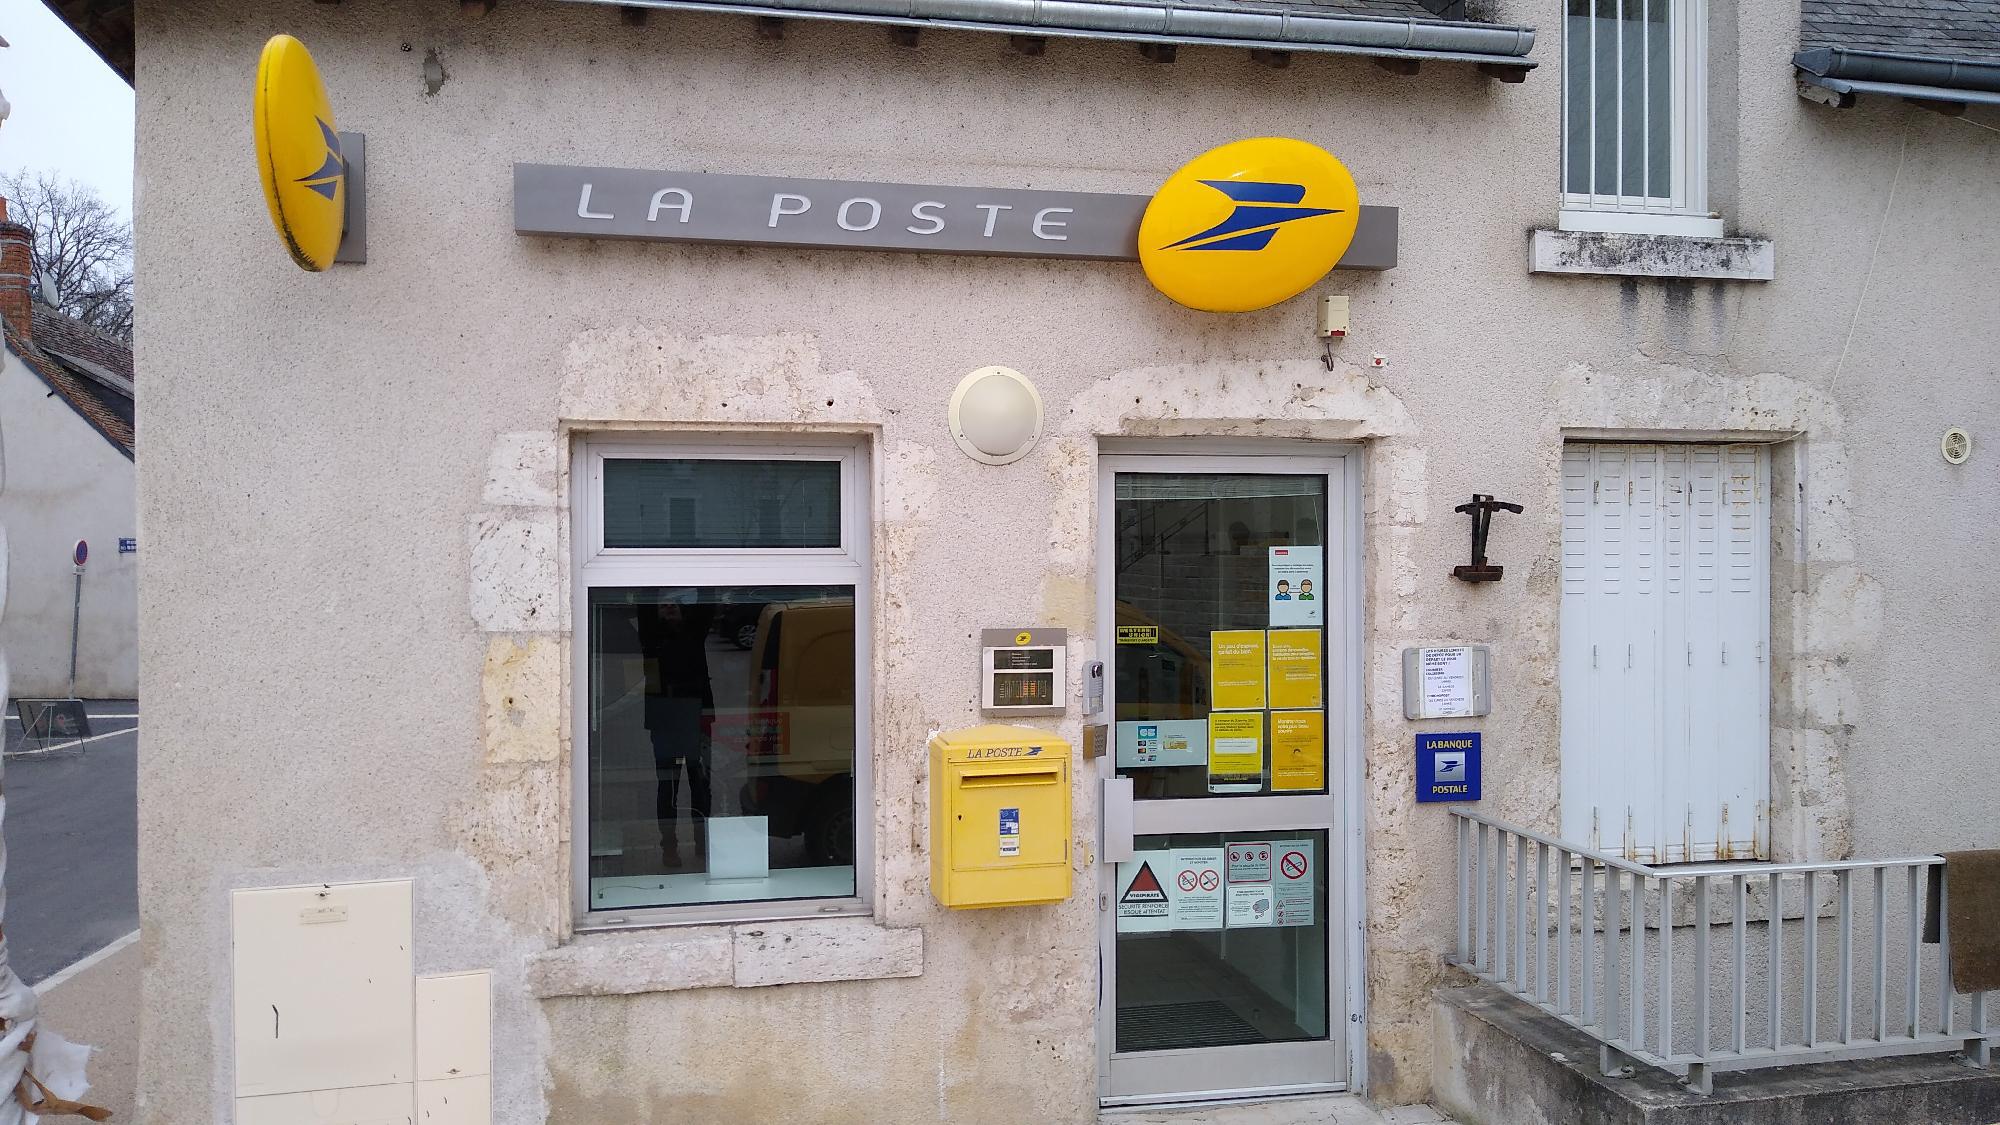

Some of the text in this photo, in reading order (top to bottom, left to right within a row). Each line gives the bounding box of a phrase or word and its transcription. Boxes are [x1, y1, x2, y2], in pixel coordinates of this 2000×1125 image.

[577, 183, 1075, 241] LA POSTE
[1426, 739, 1473, 749] LA BANQUE
[967, 747, 1023, 759] LA POSTE
[1432, 784, 1468, 794] POSTALE
